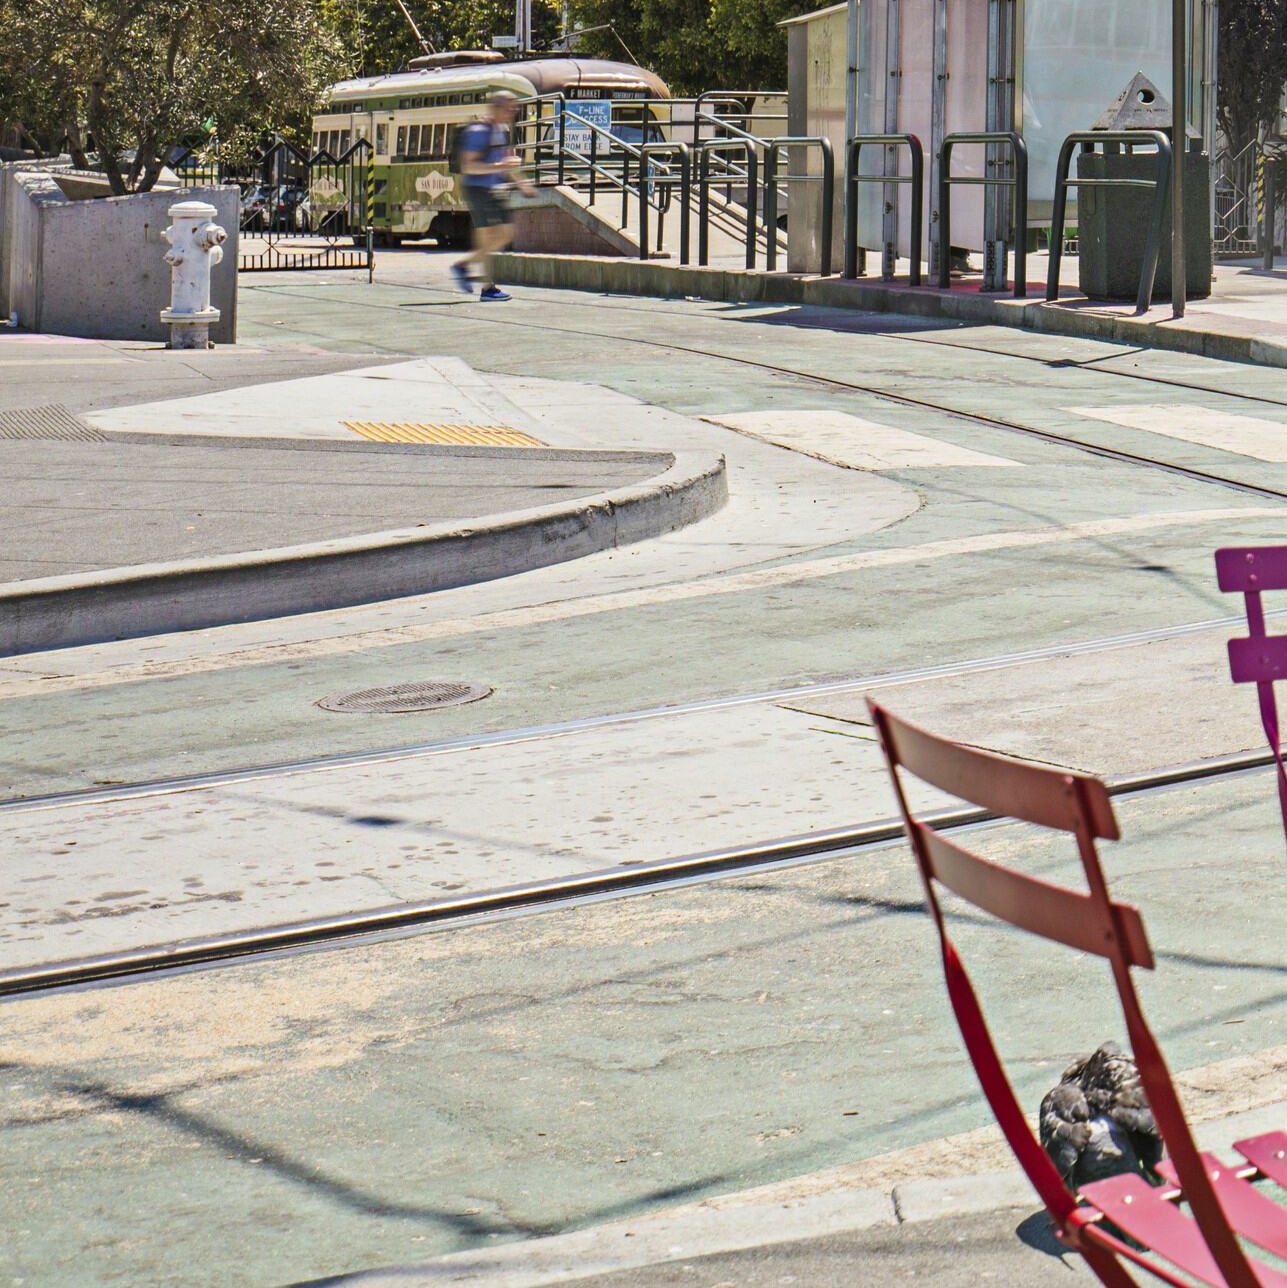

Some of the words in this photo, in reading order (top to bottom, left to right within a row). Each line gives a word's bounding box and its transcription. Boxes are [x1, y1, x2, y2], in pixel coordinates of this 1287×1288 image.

[570, 89, 575, 98] F
[577, 89, 601, 99] MARKET
[578, 105, 605, 115] F-LINE
[564, 133, 579, 142] STAY
[582, 133, 601, 142] BAK
[564, 142, 581, 151] ROM
[421, 178, 430, 188] SAN
[432, 178, 449, 188] DIEGO
